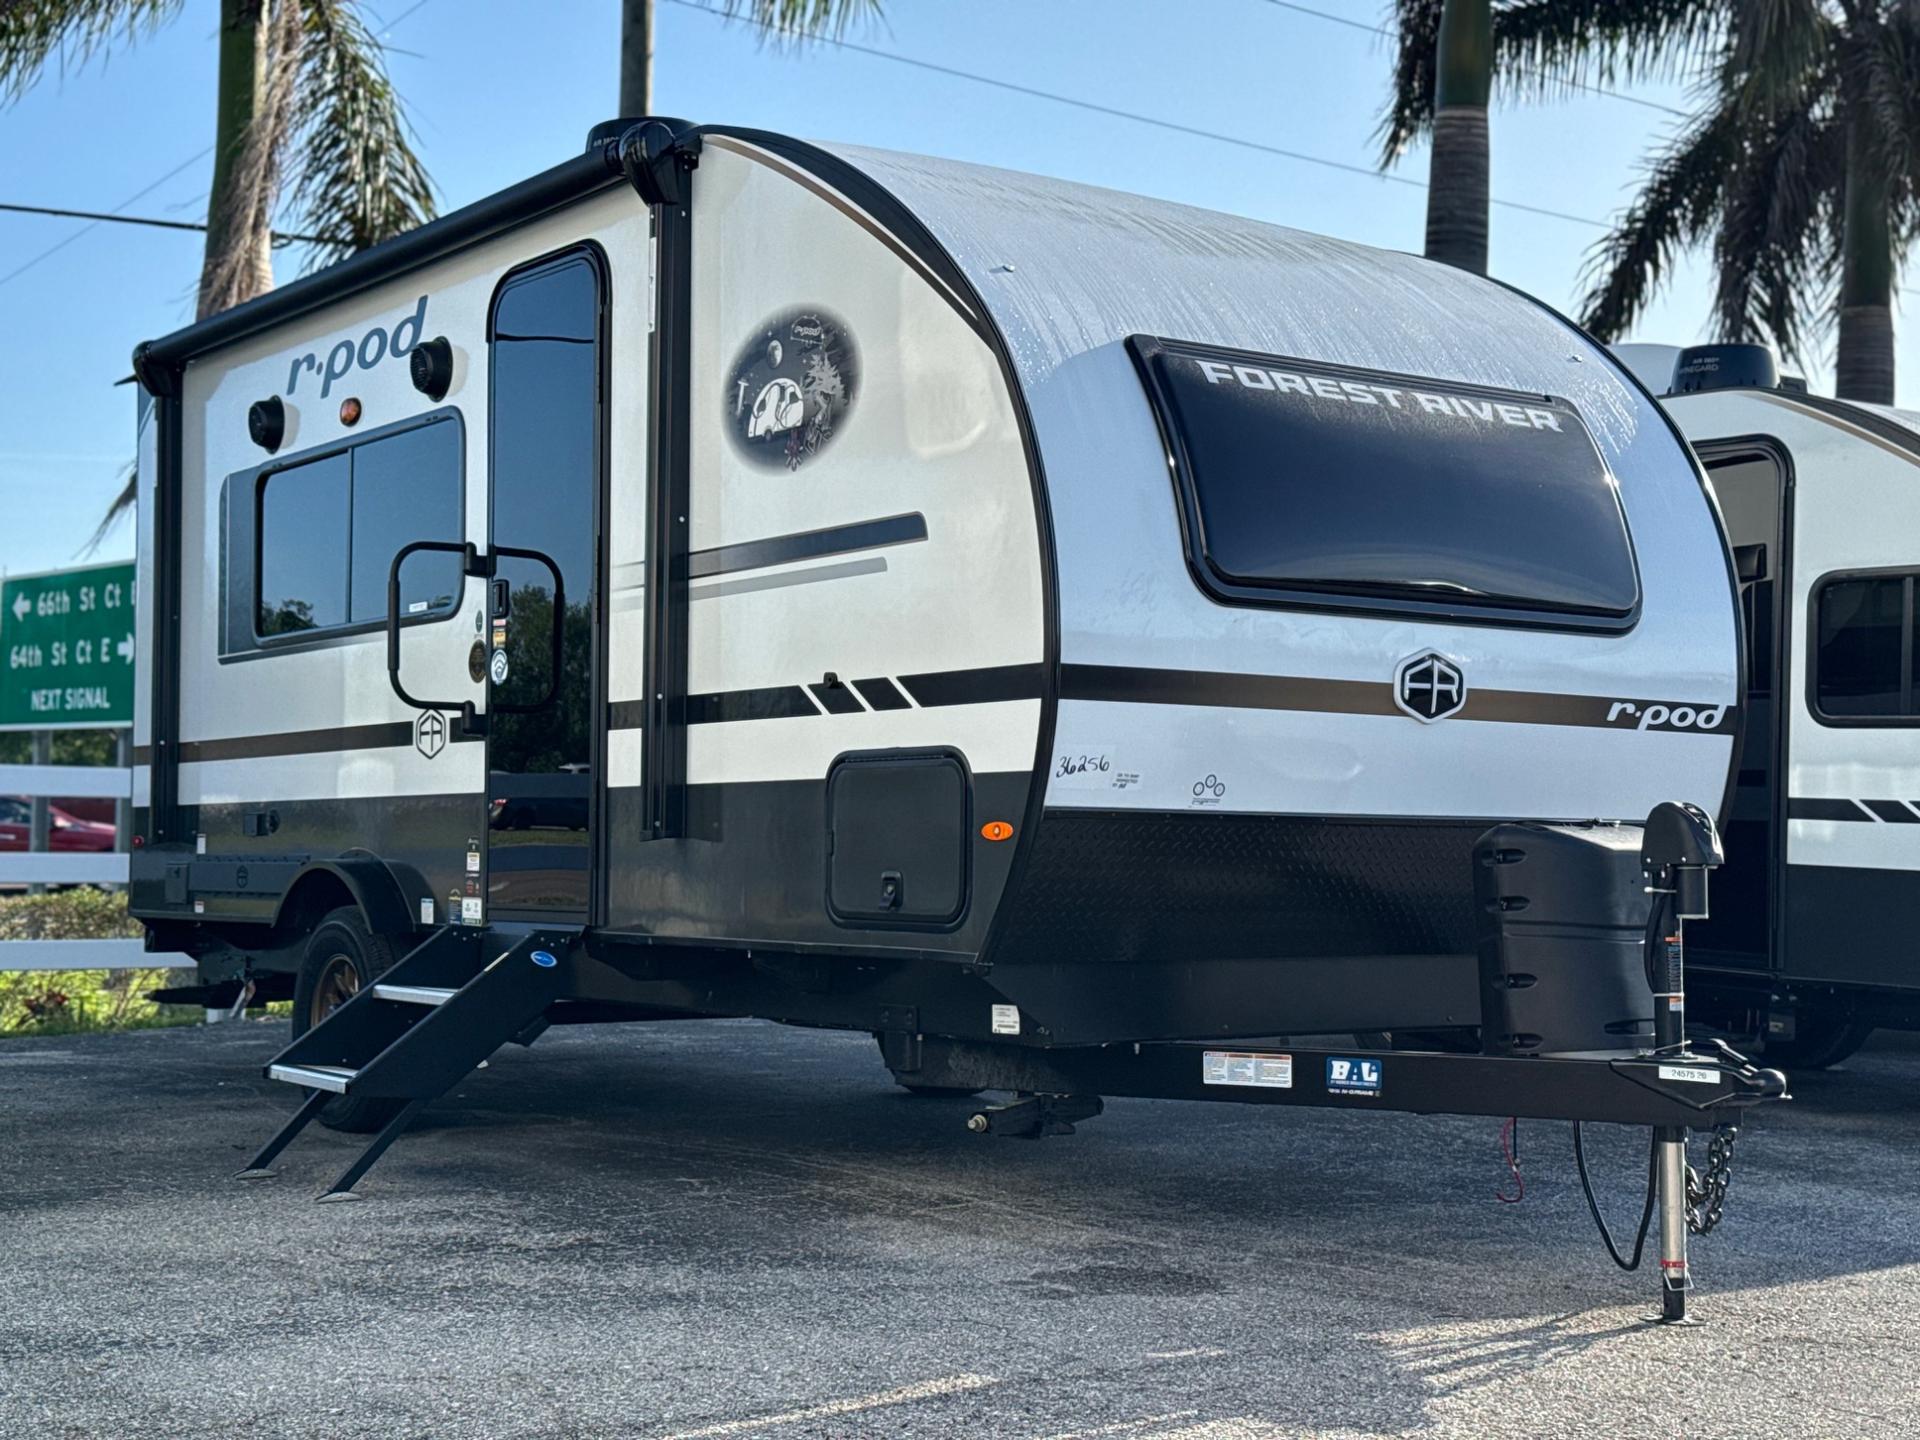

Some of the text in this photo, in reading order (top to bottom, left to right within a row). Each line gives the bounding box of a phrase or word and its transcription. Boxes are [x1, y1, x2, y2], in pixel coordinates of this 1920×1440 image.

[1194, 359, 1564, 433] FOREST RIVER
[37, 589, 71, 617] 66th
[79, 585, 96, 612] St
[104, 582, 122, 609] Ct
[10, 637, 111, 670] 64th St Ct E
[31, 686, 111, 711] NEXT SIGNAL
[1055, 755, 1111, 779] 36256
